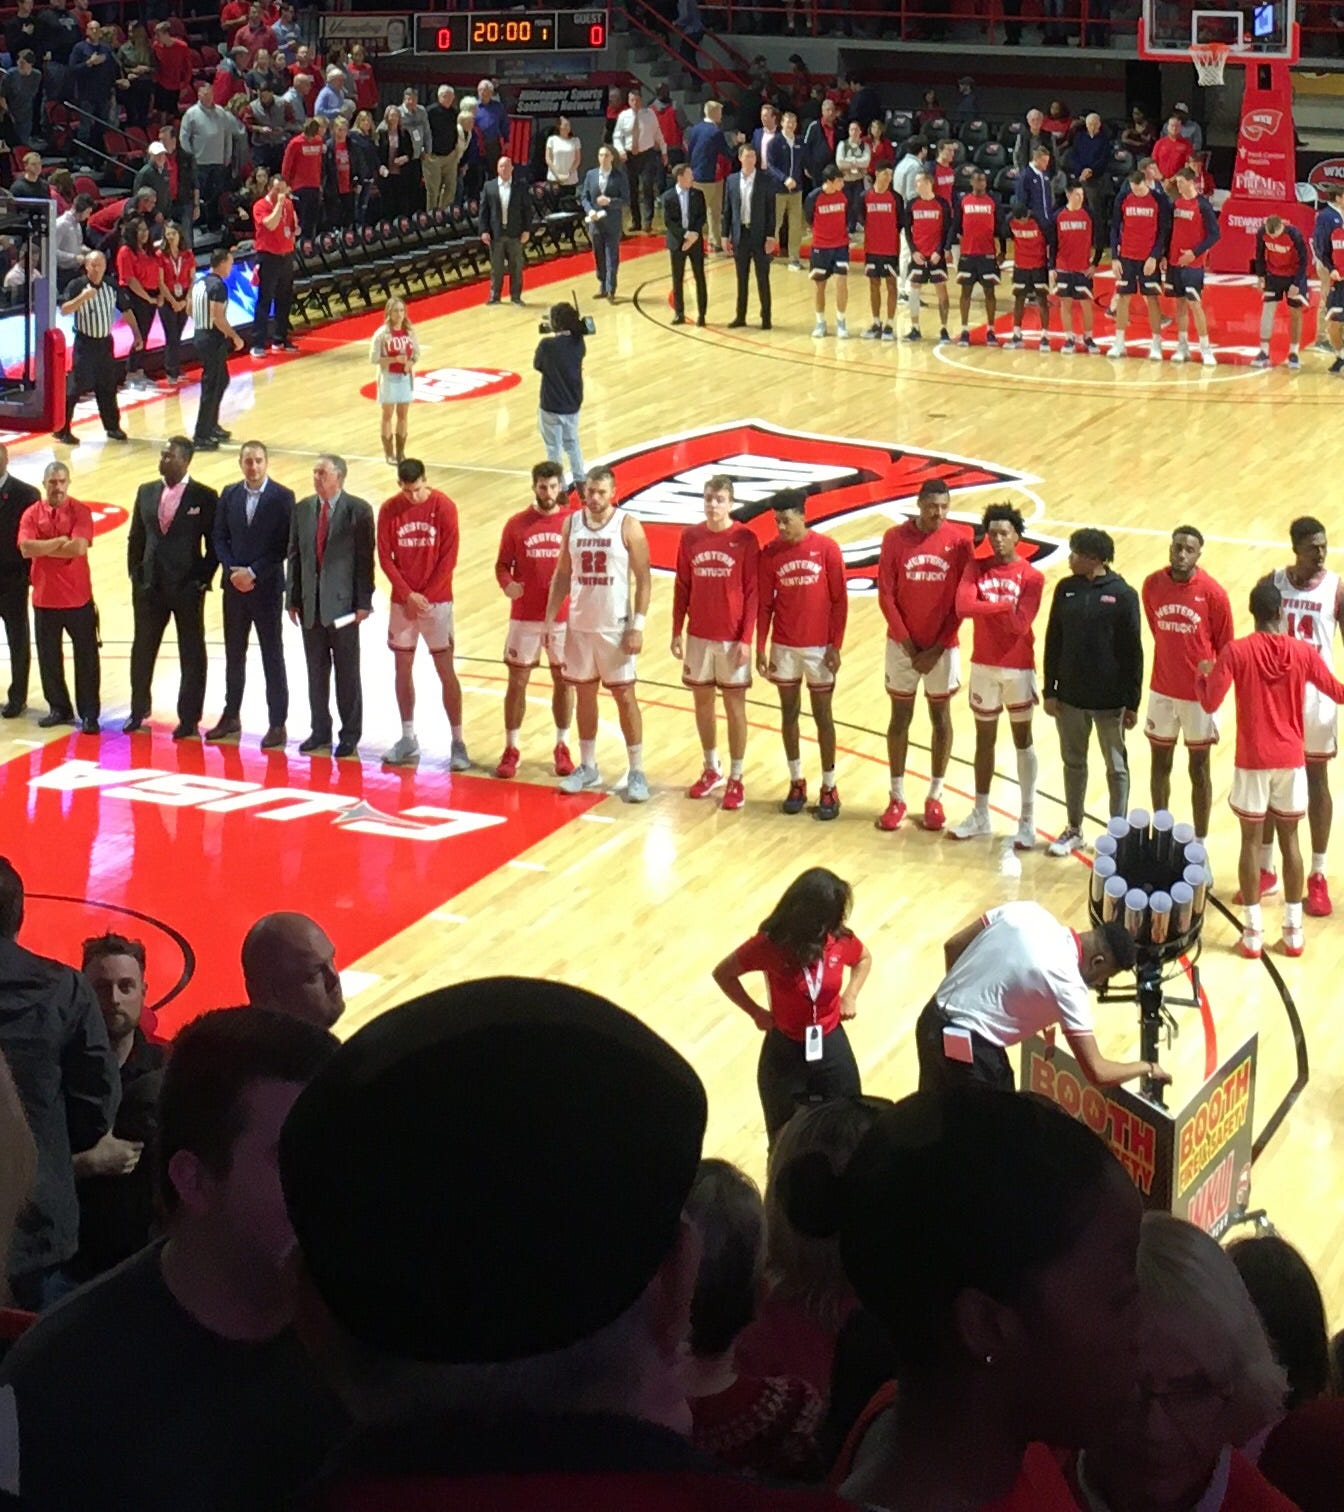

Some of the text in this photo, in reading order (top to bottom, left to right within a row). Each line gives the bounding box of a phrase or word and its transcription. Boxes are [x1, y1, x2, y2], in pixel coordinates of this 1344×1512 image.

[437, 29, 451, 50] 0
[474, 21, 531, 42] 20:00
[590, 25, 604, 46] 0
[580, 550, 607, 574] 22
[692, 550, 735, 568] WESTERN
[776, 559, 822, 577] WESTERN
[903, 554, 950, 571] WESTERN
[1155, 603, 1201, 624] WESTERN
[1031, 1052, 1156, 1169] BOOTH
[1179, 1055, 1252, 1167] BOOTH
